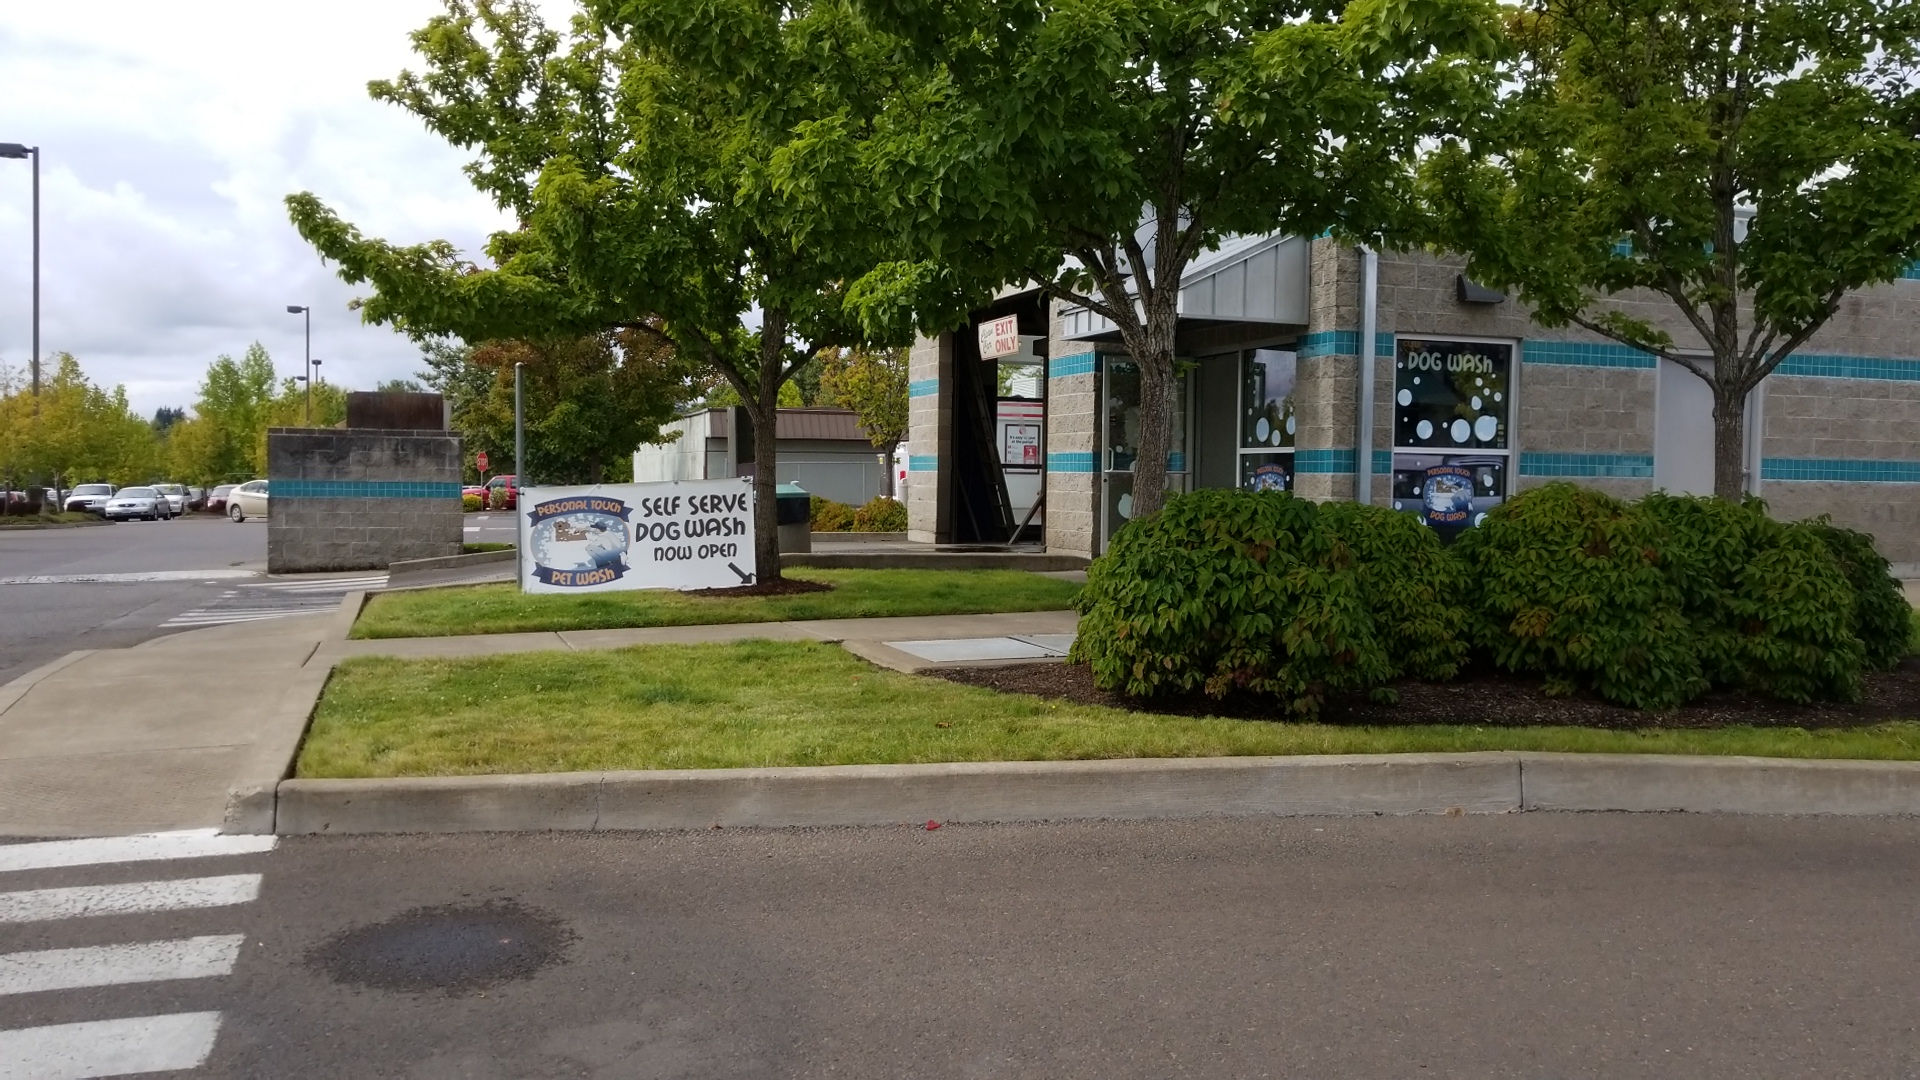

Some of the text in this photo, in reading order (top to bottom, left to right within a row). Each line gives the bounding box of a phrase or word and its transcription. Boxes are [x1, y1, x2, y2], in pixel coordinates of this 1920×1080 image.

[995, 319, 1013, 337] EXIT
[995, 336, 1015, 353] ONLY
[1408, 352, 1442, 371] DOG
[478, 457, 487, 466] STOP
[537, 500, 622, 517] PERSONAL TOUCH
[642, 493, 748, 517] SELF SERVE
[1430, 510, 1445, 521] DOG
[636, 521, 680, 542] DOG
[653, 543, 738, 561] NOW OPEN
[551, 571, 573, 585] PET
